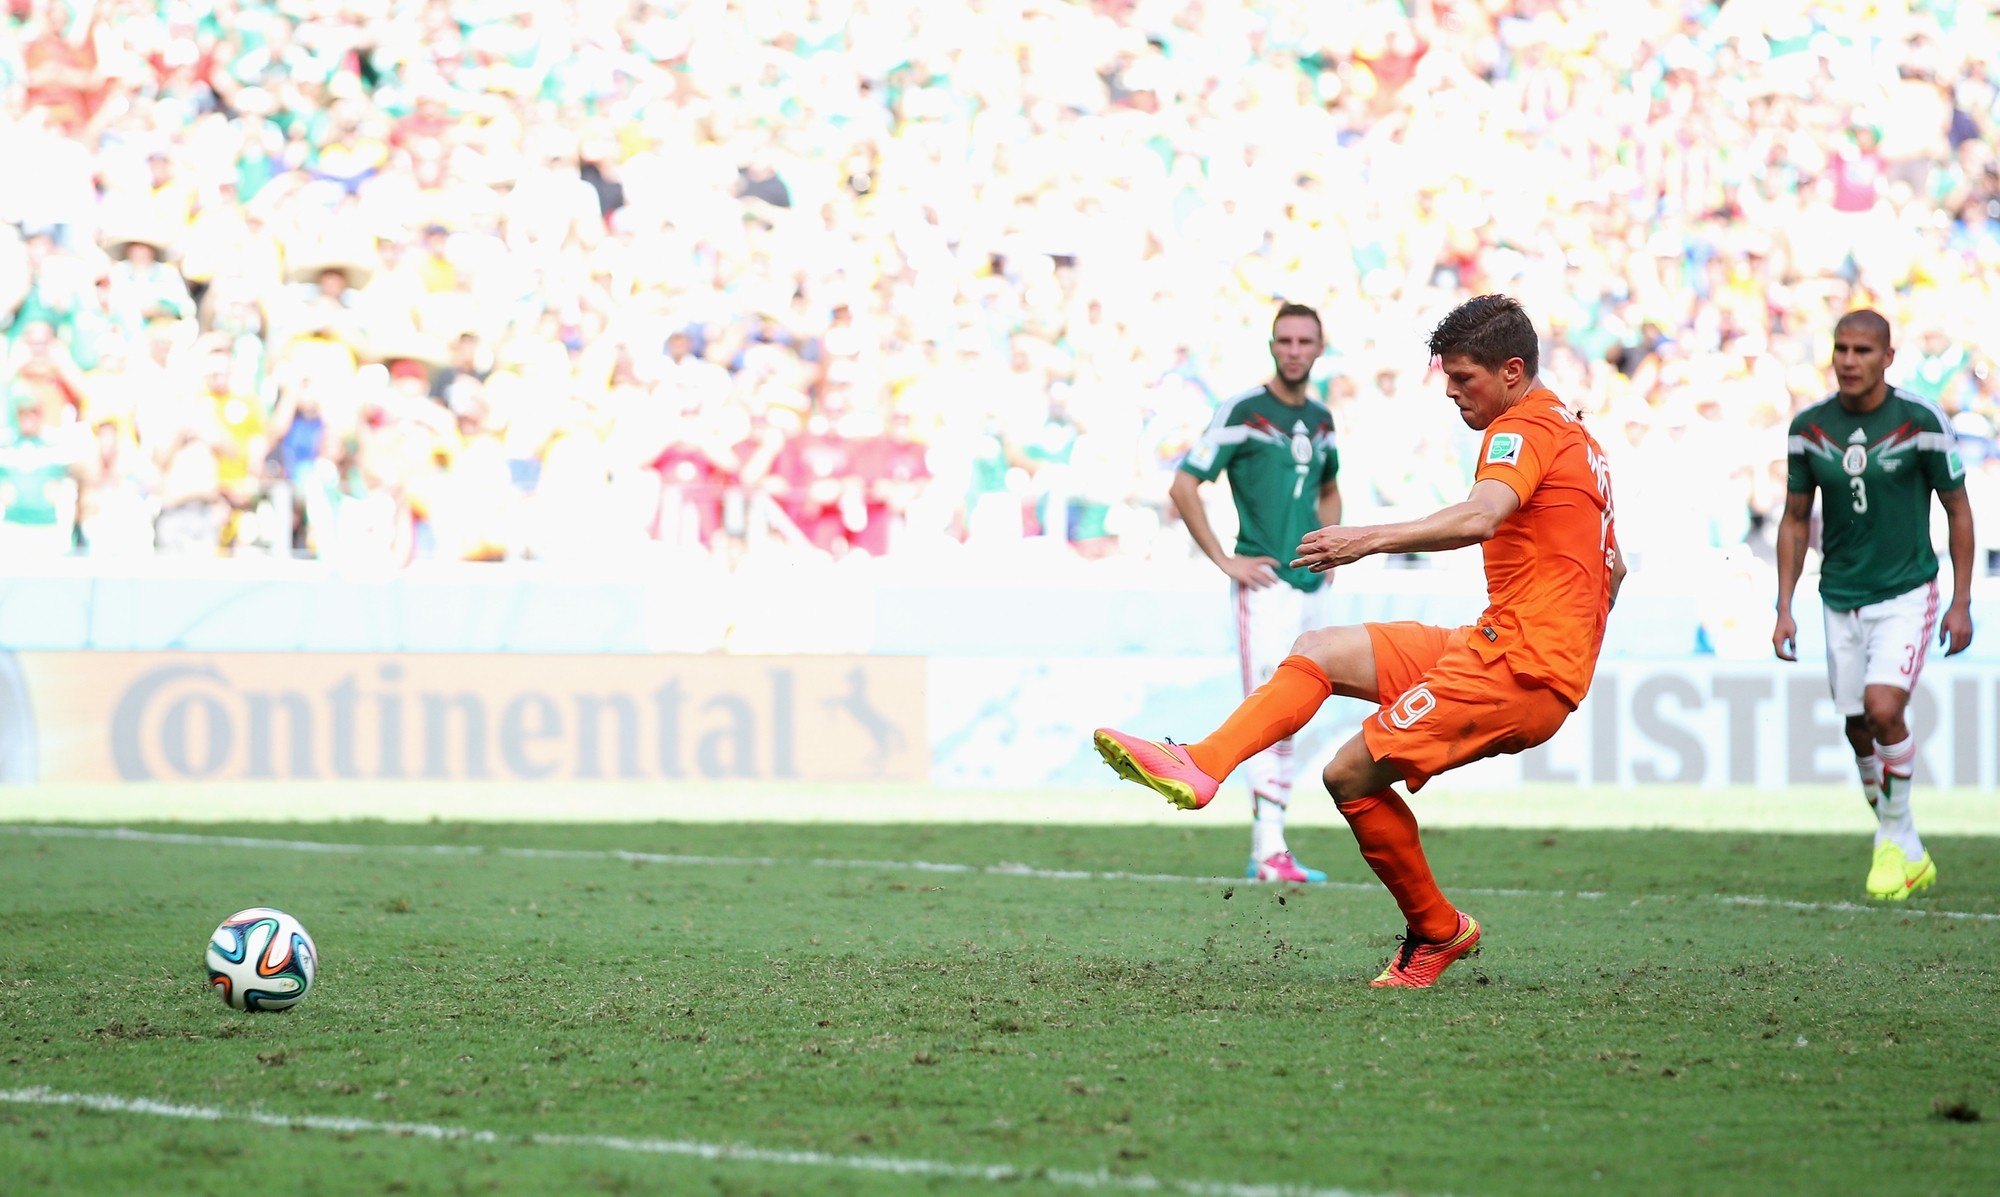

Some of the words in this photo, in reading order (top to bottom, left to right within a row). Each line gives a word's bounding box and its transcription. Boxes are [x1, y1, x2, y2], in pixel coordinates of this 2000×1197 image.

[1293, 464, 1310, 499] 7
[1849, 476, 1868, 514] 3
[1900, 643, 1916, 675] 3
[110, 661, 801, 781] Continental
[1522, 673, 2000, 784] LISTERI
